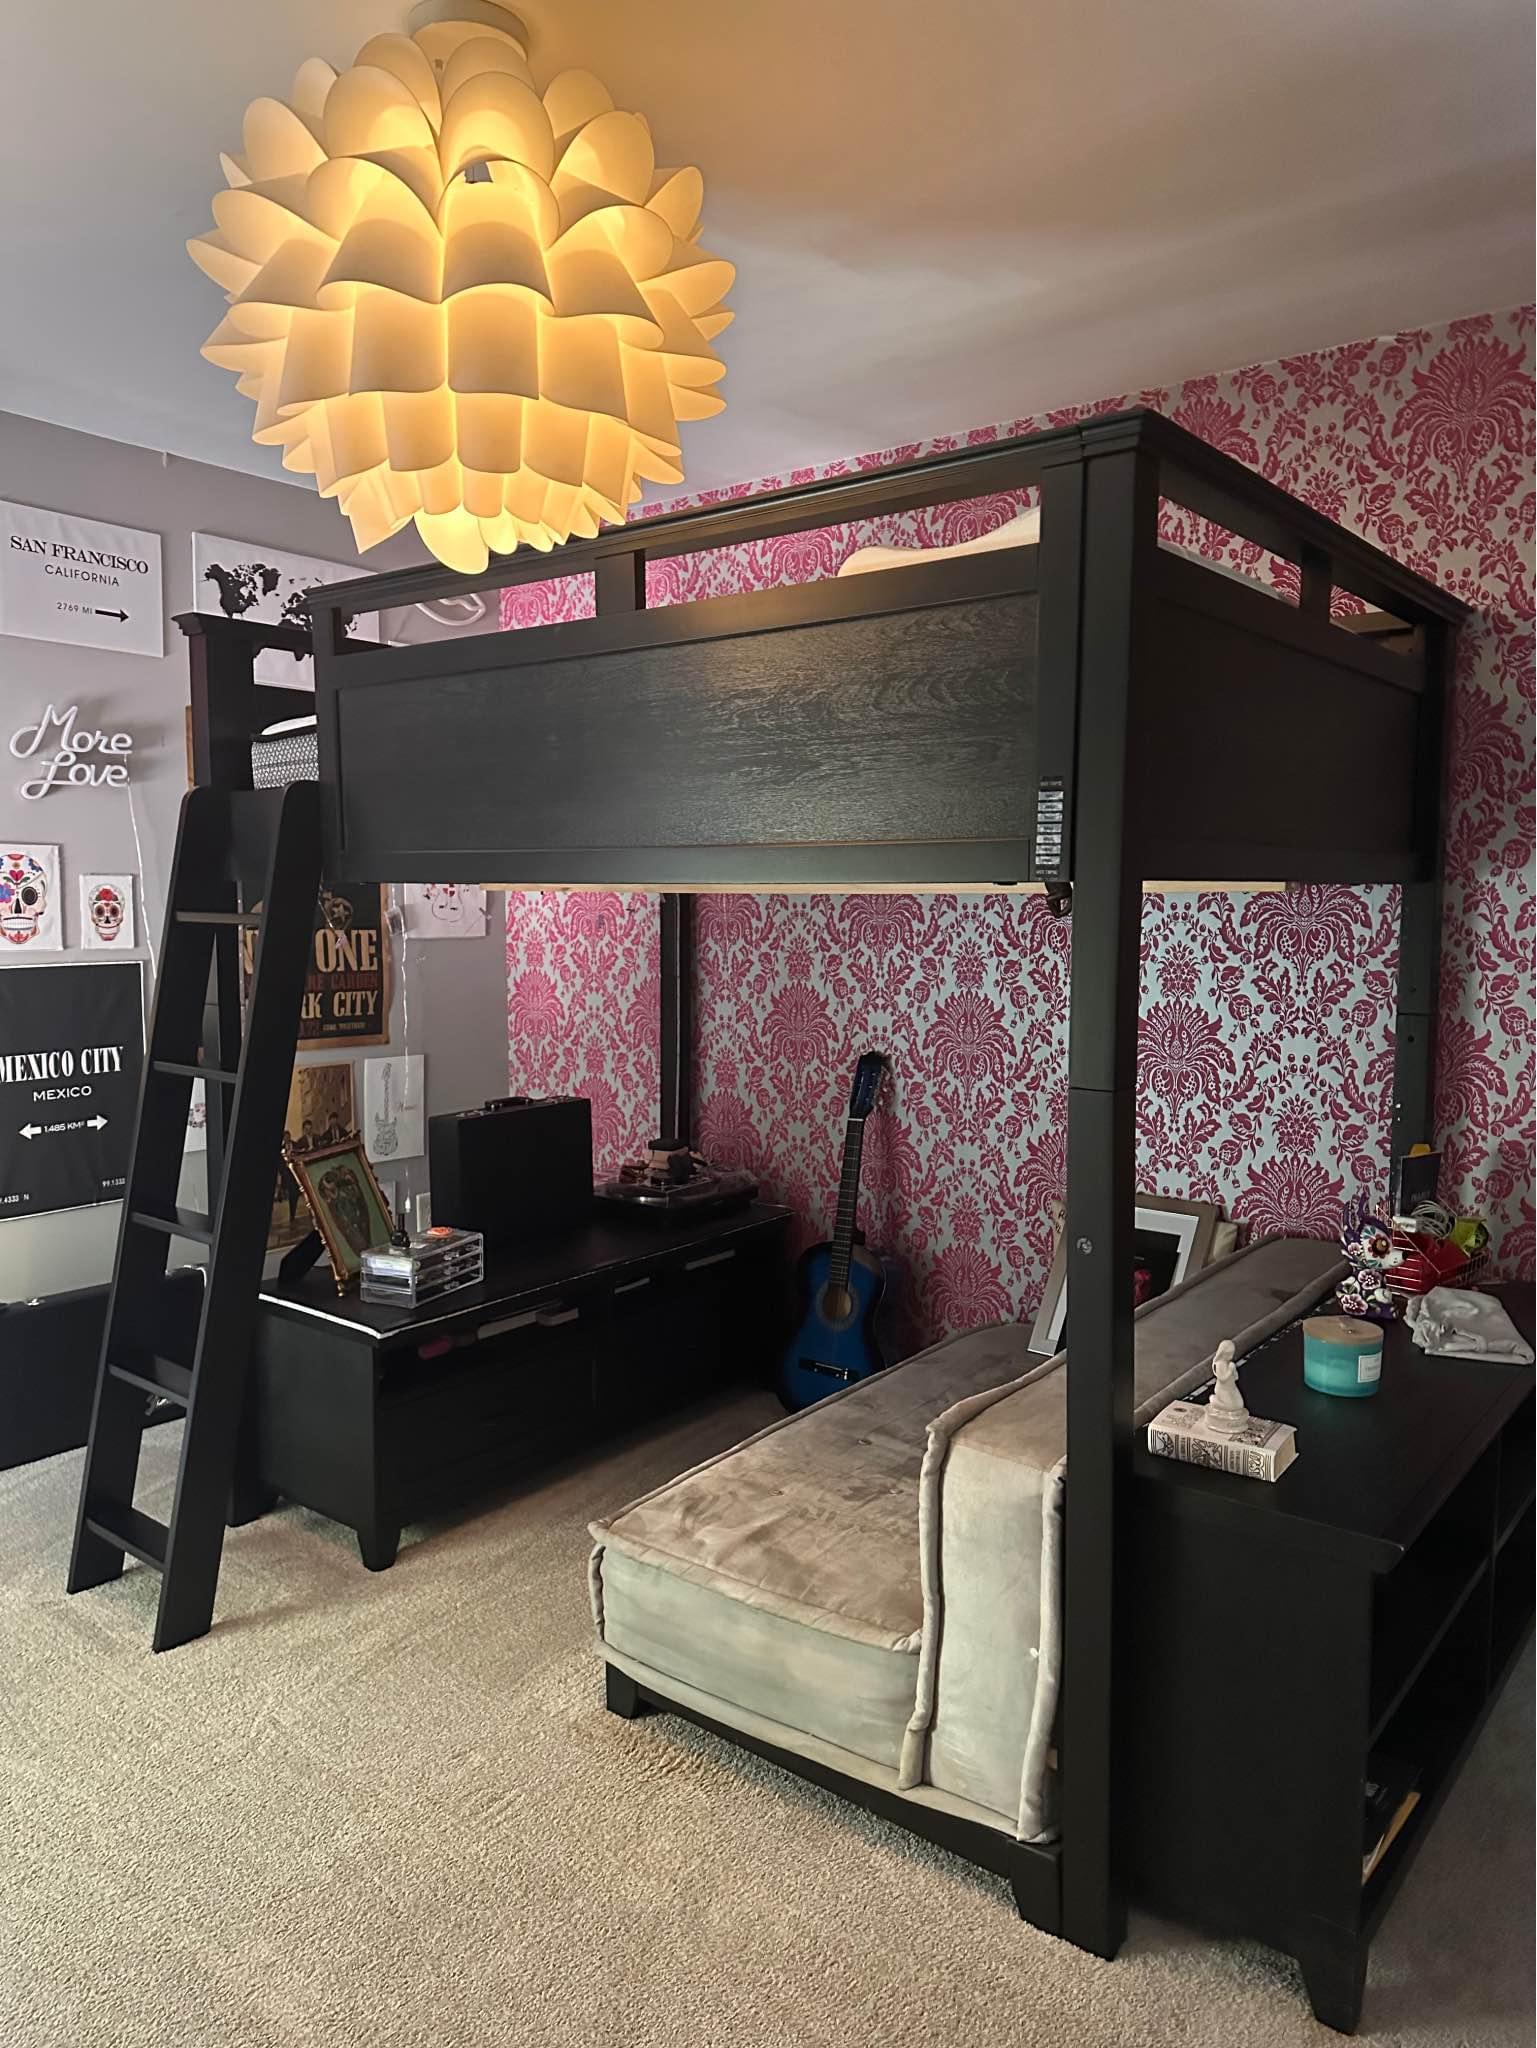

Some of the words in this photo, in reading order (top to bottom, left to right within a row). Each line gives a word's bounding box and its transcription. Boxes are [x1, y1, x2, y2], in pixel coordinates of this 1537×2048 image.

[10, 535, 47, 555] SAN
[51, 543, 149, 574] FRANCISCO
[44, 564, 120, 587] CALIFORNIA
[56, 602, 79, 613] 2769
[82, 606, 93, 615] MI
[9, 704, 133, 758] More
[20, 750, 128, 800] Love
[333, 990, 378, 1017] CITY
[0, 1050, 74, 1083] MEXICO
[80, 1046, 124, 1076] CITY
[33, 1085, 92, 1102] MEXICO
